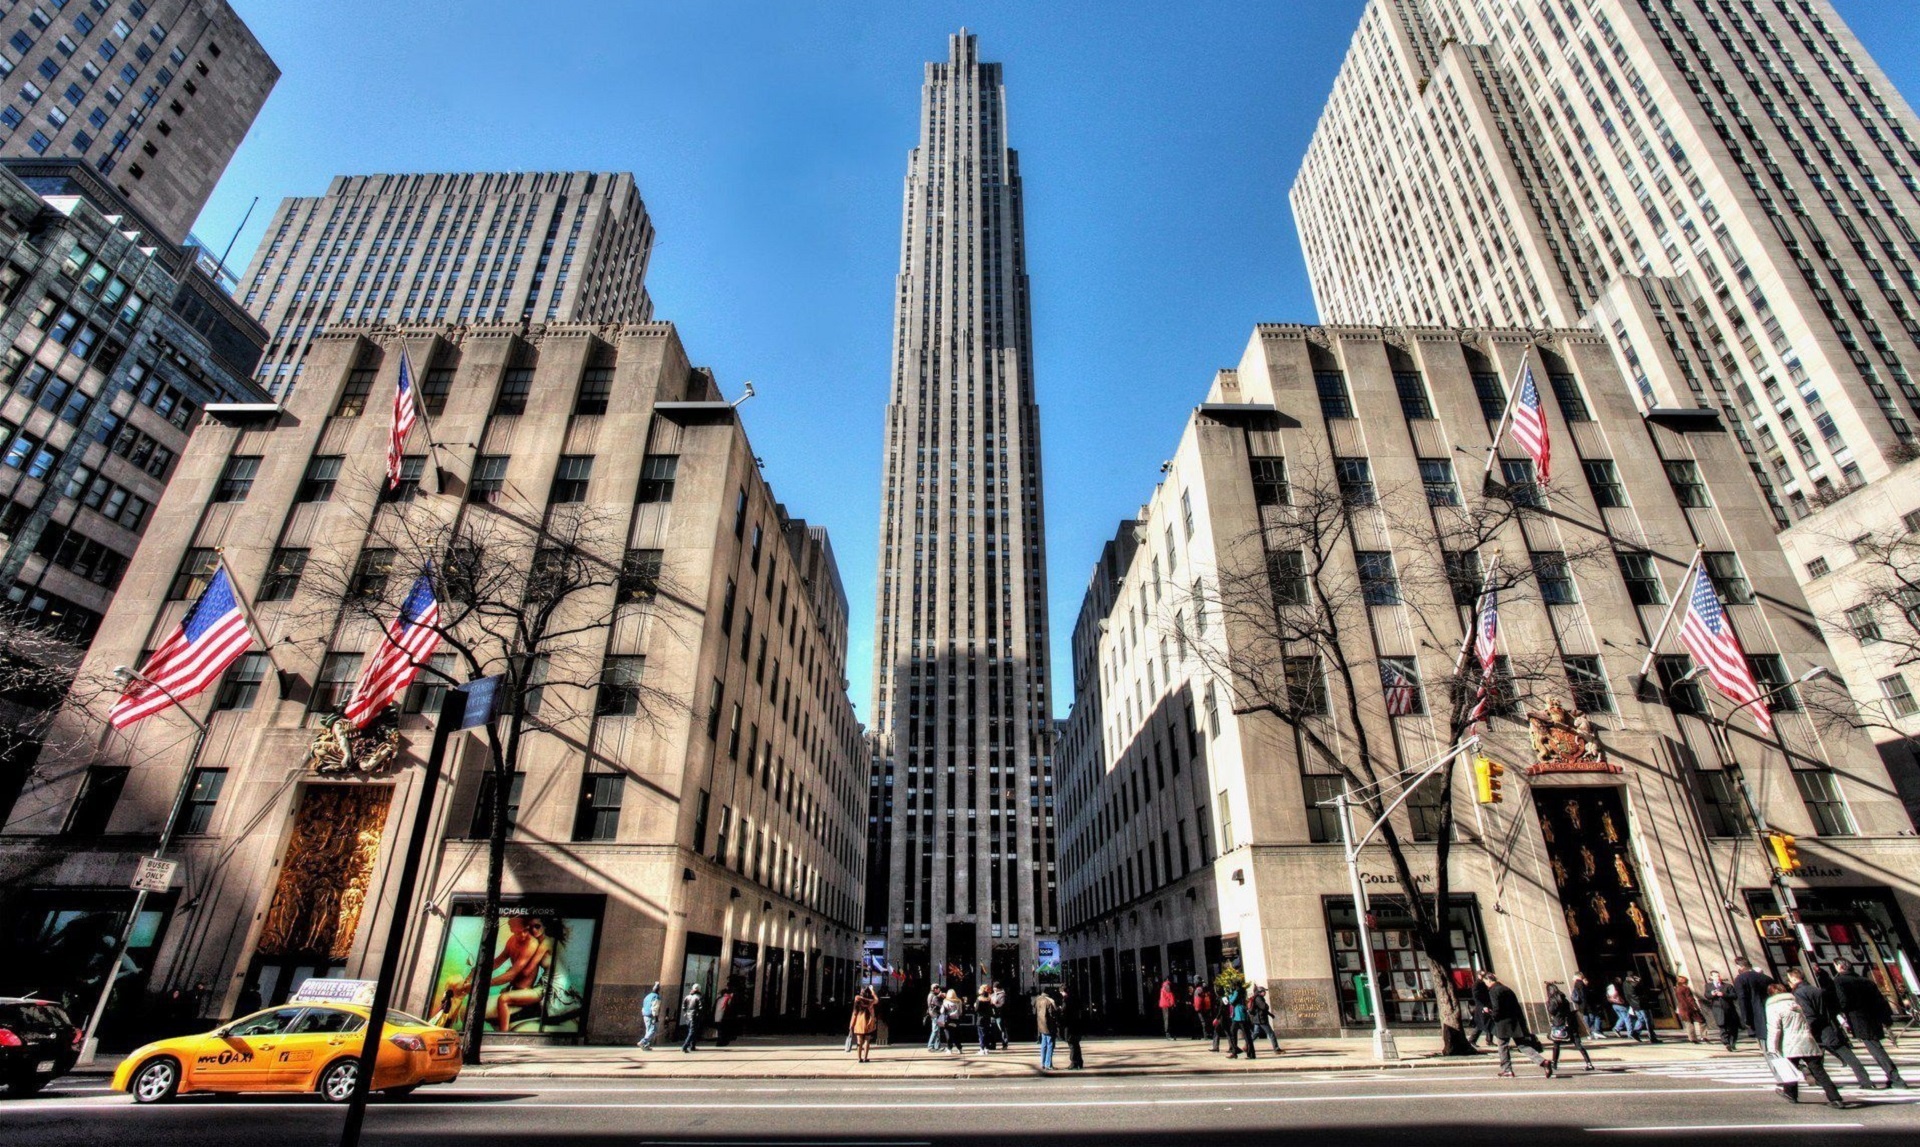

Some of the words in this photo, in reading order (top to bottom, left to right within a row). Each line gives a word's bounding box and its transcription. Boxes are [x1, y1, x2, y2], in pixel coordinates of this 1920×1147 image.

[147, 861, 170, 869] BUSES
[145, 871, 164, 879] ONLY
[302, 981, 338, 991] PRIVATE
[198, 1055, 216, 1063] NYC
